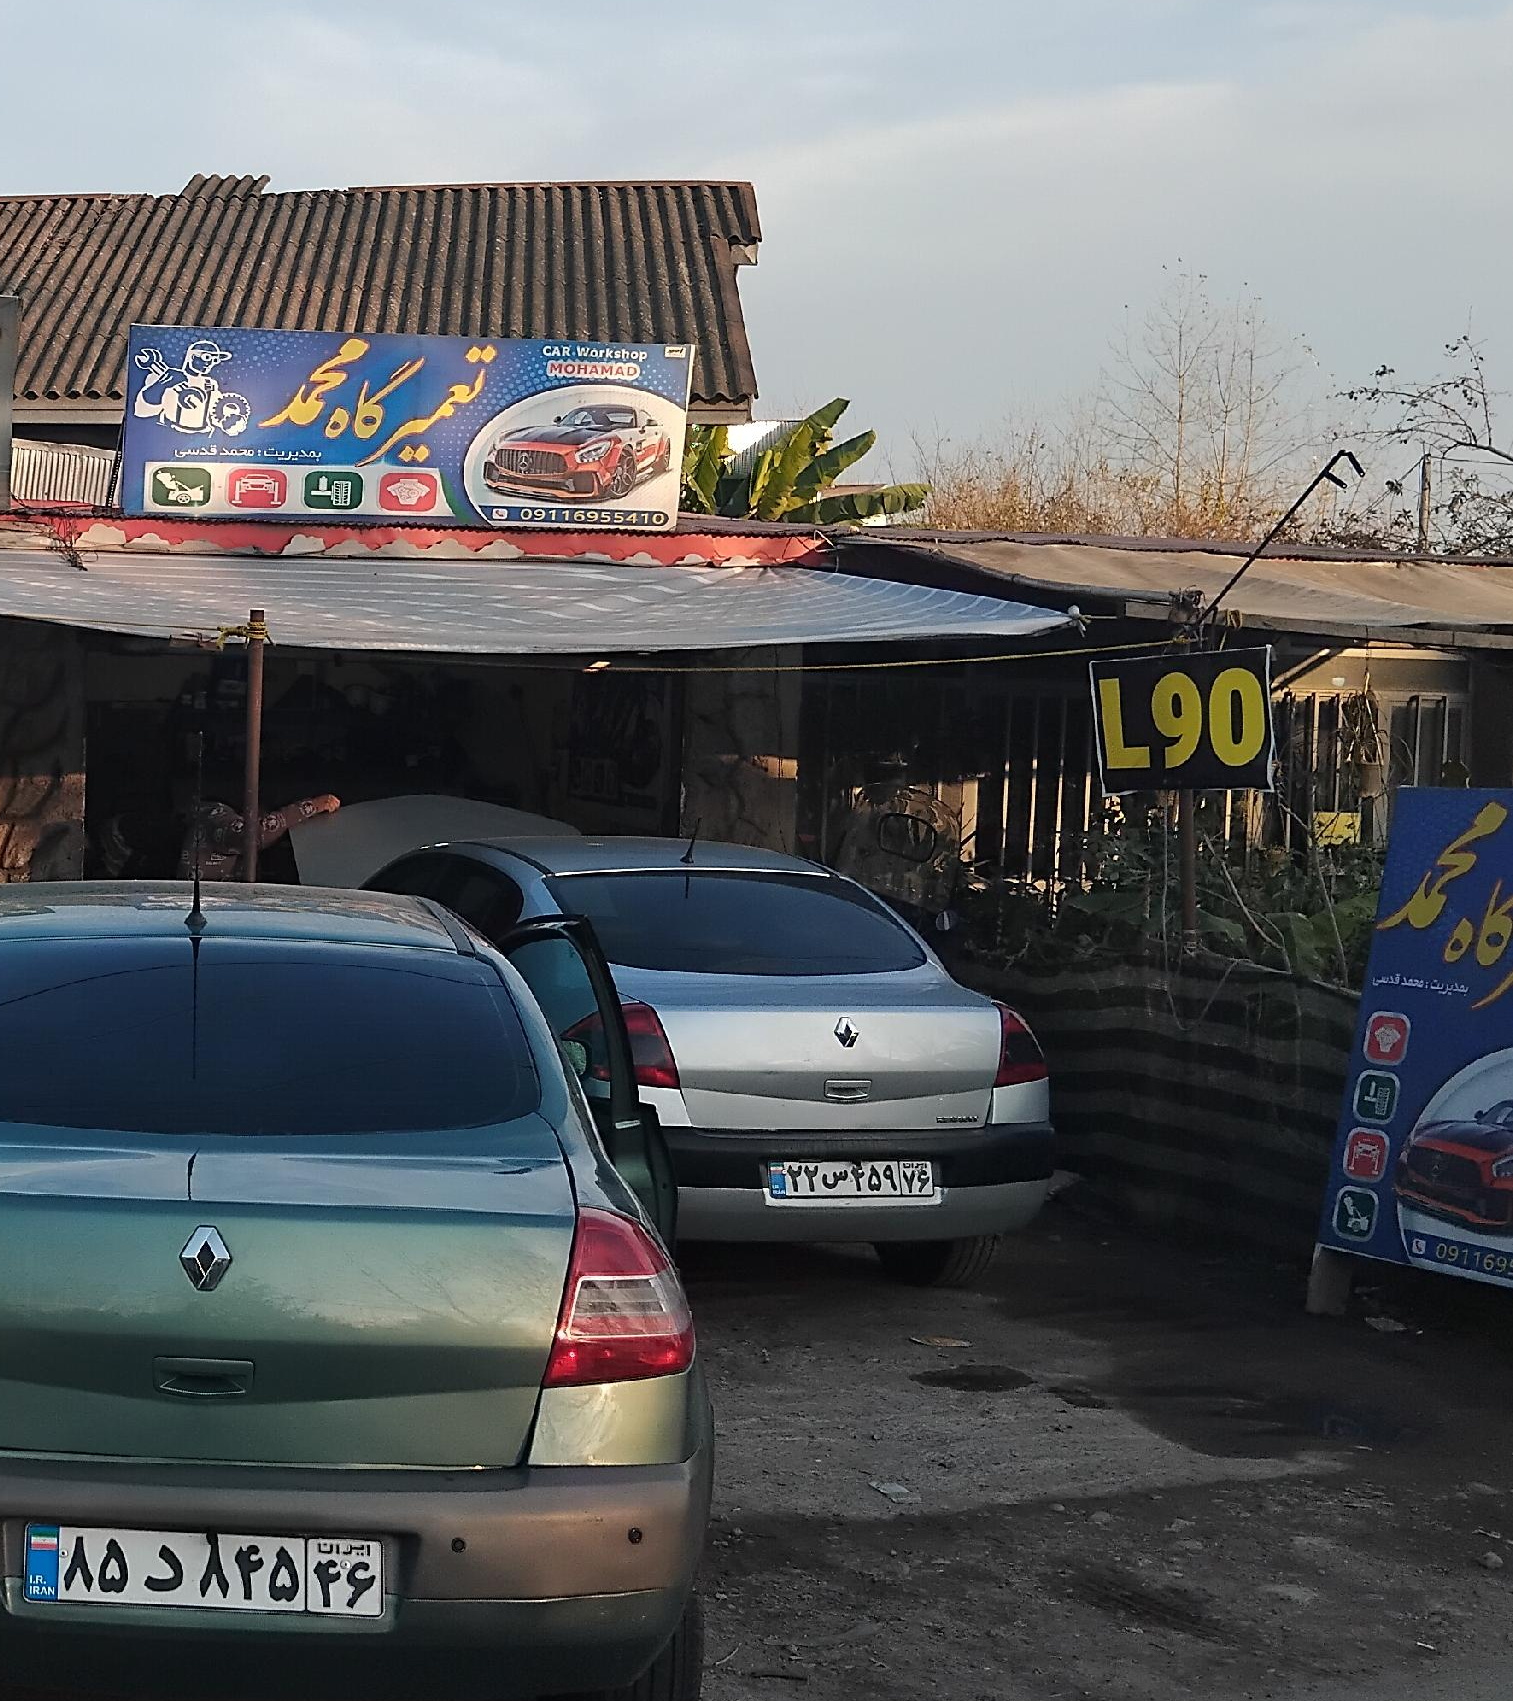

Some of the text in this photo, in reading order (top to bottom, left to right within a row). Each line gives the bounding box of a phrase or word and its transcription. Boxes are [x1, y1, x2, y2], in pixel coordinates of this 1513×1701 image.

[542, 345, 648, 362] CAR Workshop
[549, 362, 638, 377] MOHAMAD
[258, 337, 371, 428] محمد
[175, 444, 218, 458] قدسی
[219, 447, 255, 457] محمد
[520, 508, 666, 525] 09116955410
[1099, 668, 1265, 769] L90
[1376, 801, 1507, 930] محمد
[1372, 973, 1401, 987] قدسی
[1401, 977, 1424, 988] محمد
[902, 1169, 930, 1193] ۷۶
[317, 1542, 372, 1557] ایران
[63, 1536, 130, 1595] ۸۵
[198, 1532, 300, 1602] ۸۴۵
[29, 1574, 47, 1585] I.R.
[312, 1559, 376, 1609] ۴۶
[29, 1585, 56, 1597] IRAN
